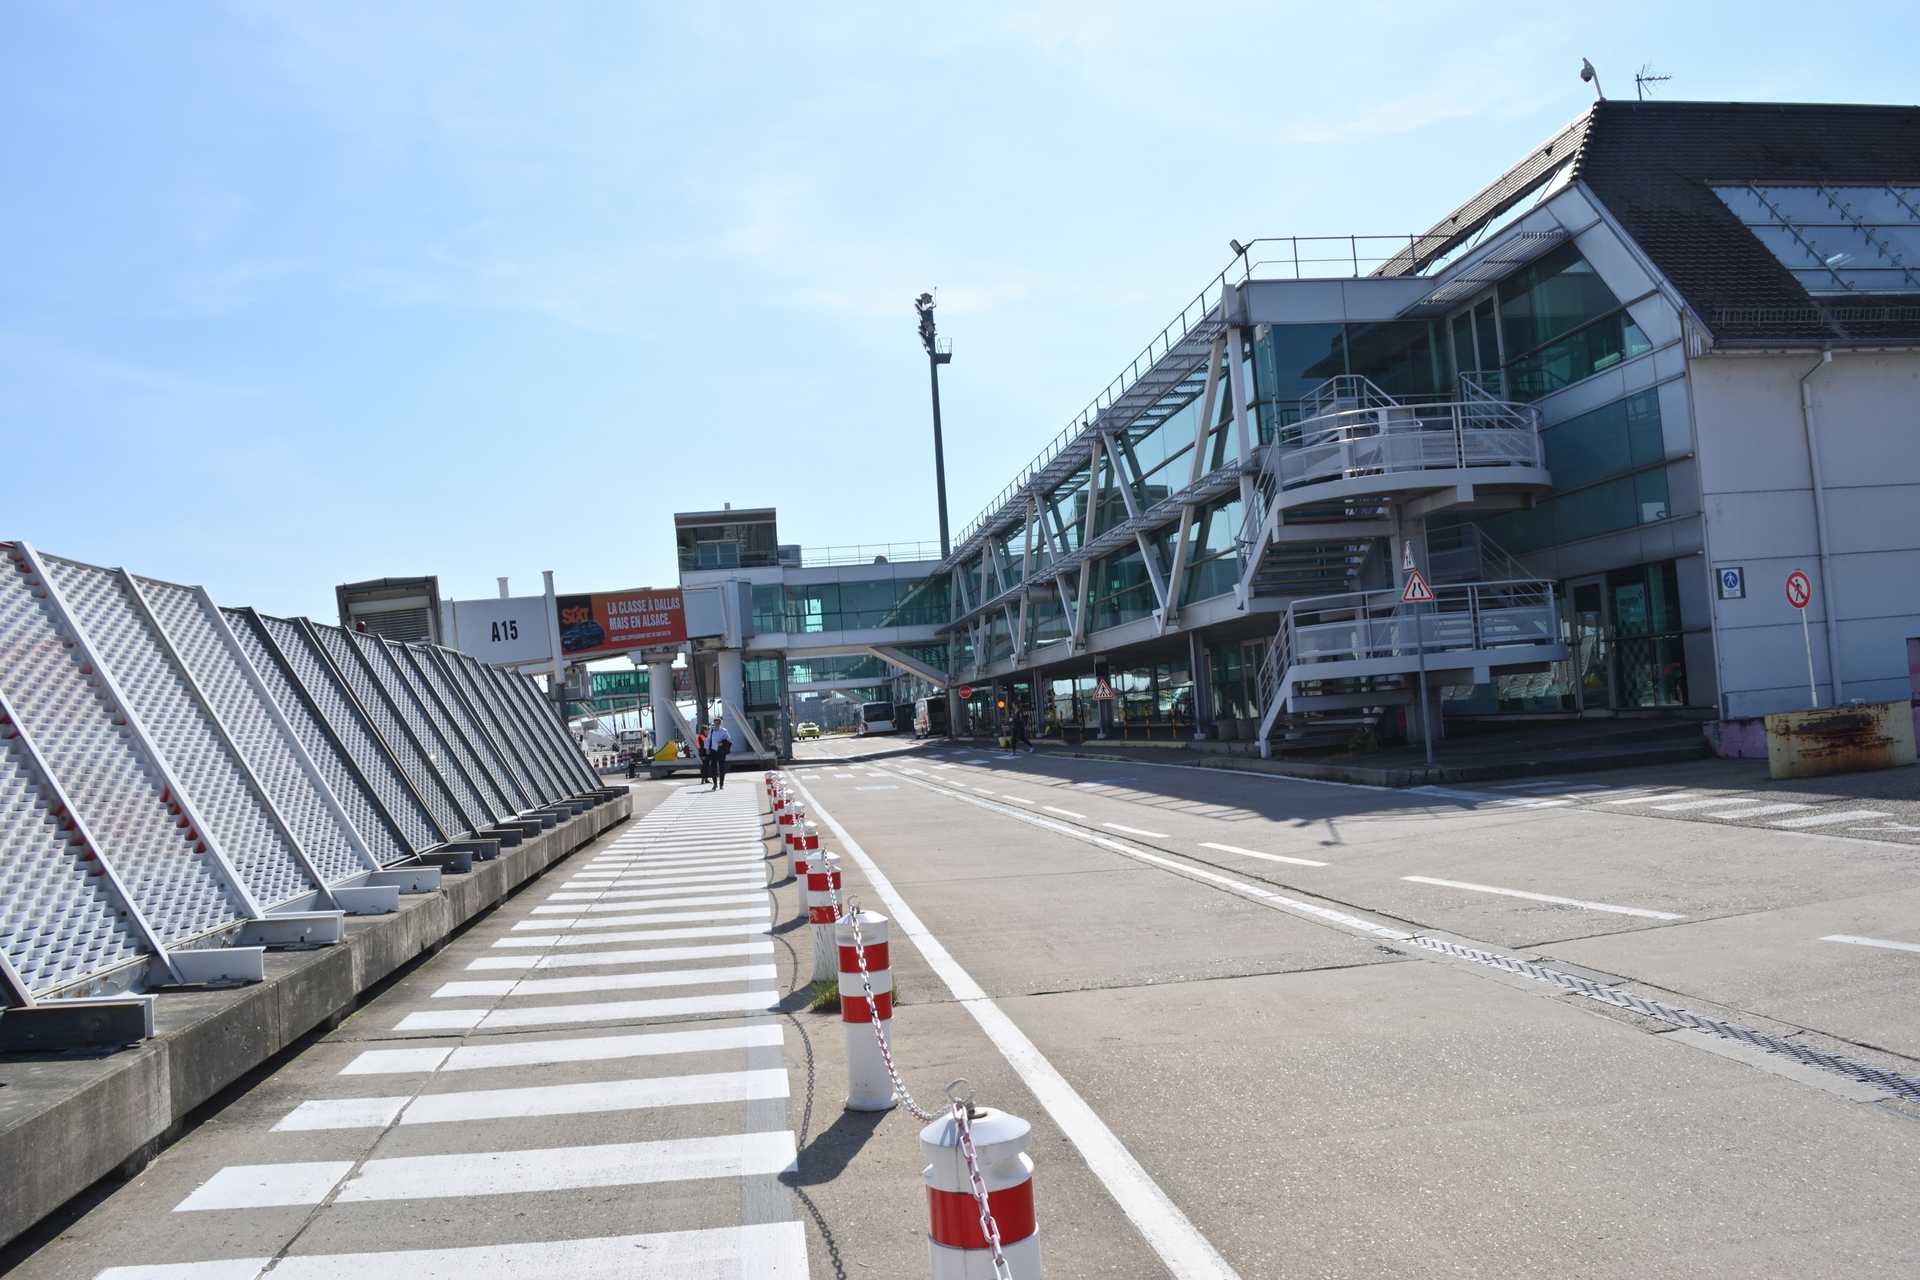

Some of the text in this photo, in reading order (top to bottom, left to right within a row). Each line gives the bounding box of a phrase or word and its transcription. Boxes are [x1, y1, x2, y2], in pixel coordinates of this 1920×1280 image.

[607, 602, 618, 615] LA
[619, 600, 647, 614] CLASSE
[654, 597, 681, 611] DALLAS
[608, 612, 672, 630] MAIS EN ALSACE.
